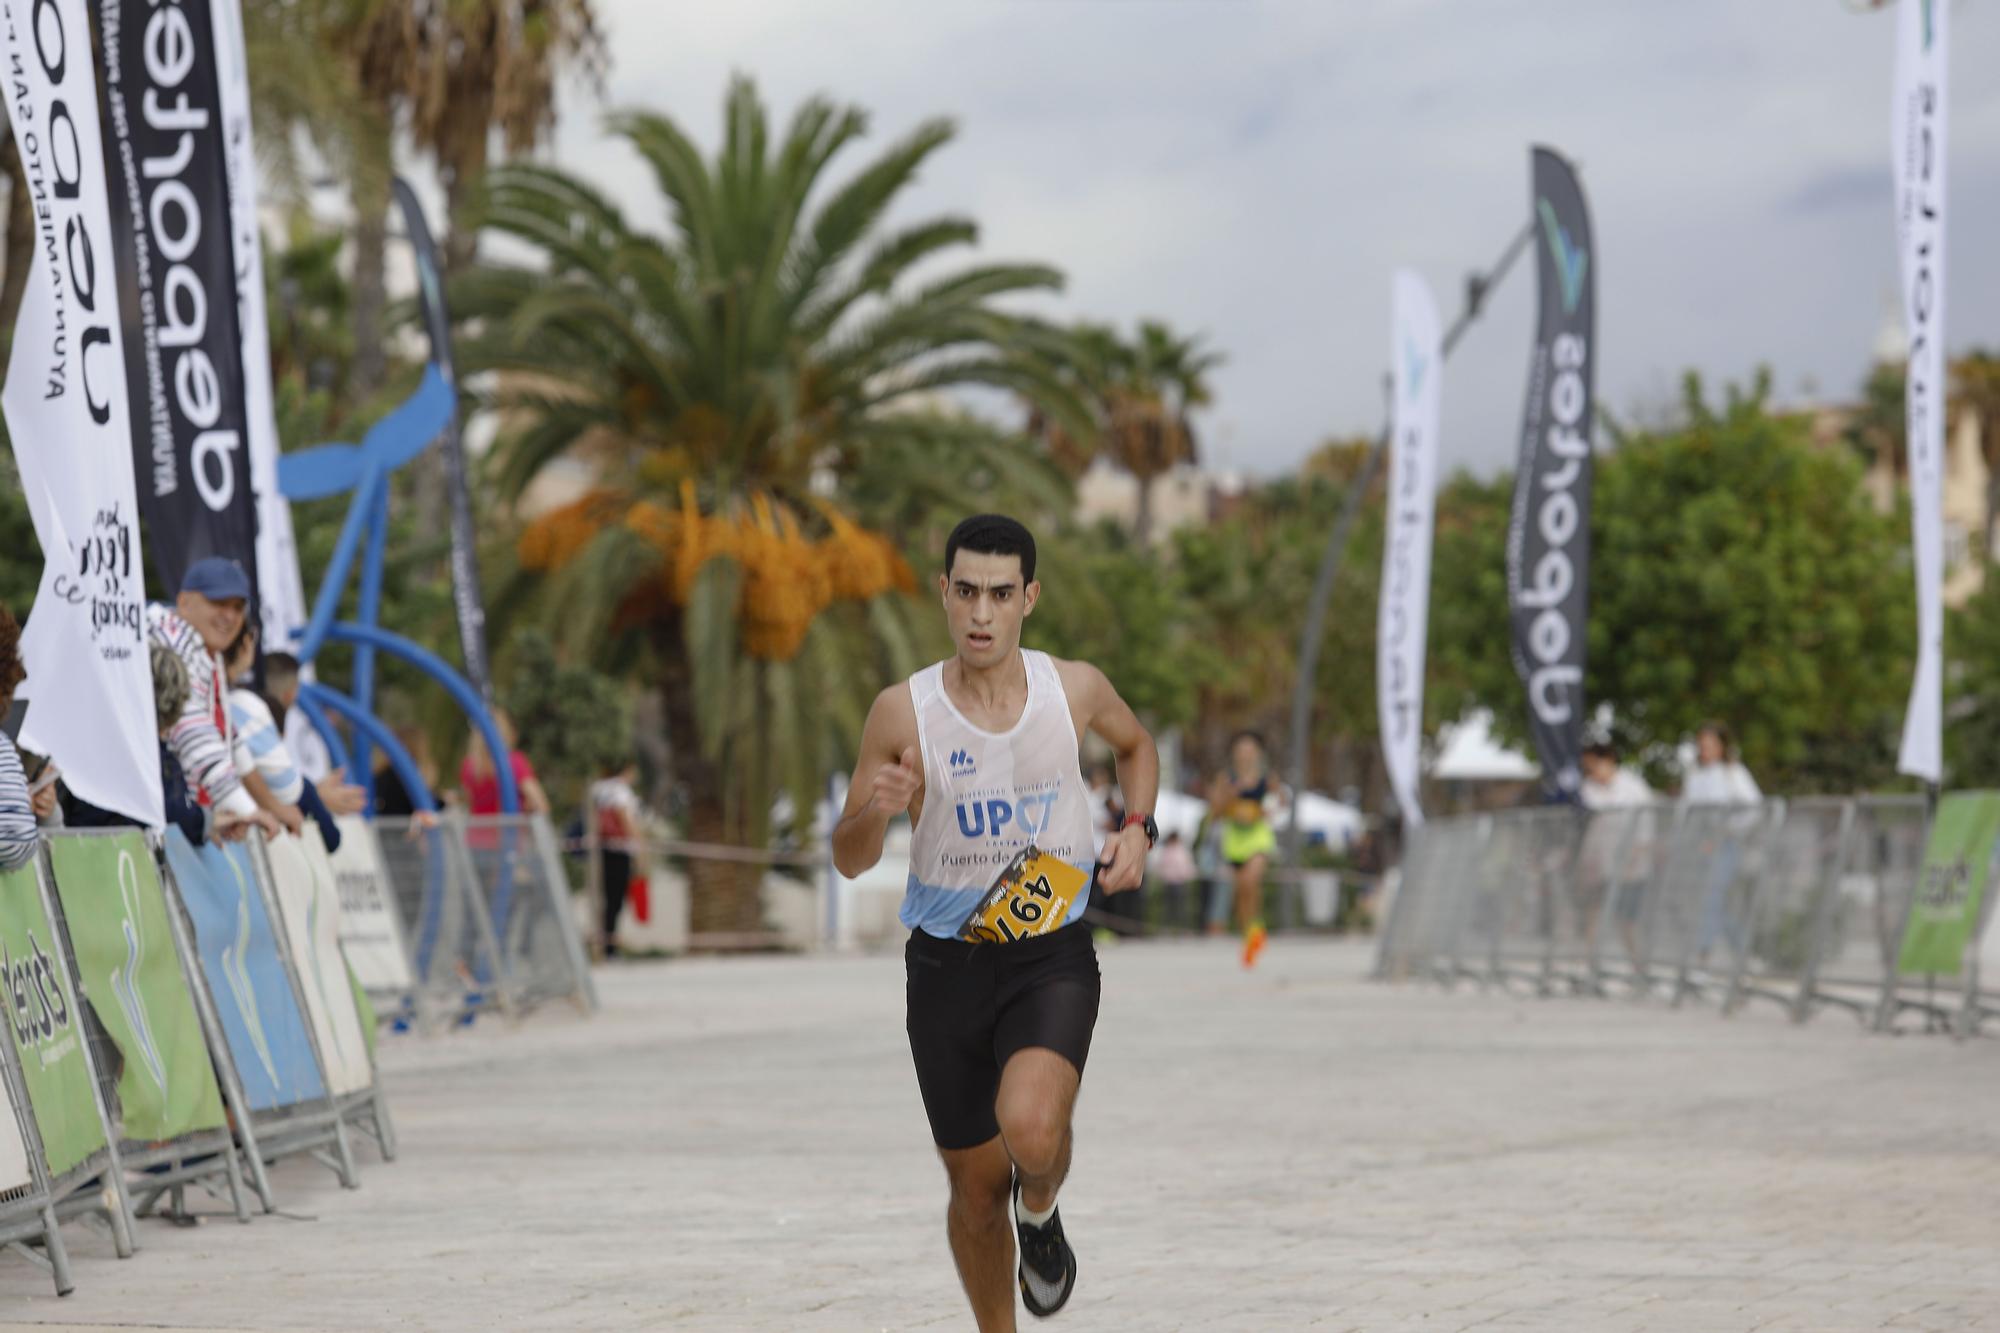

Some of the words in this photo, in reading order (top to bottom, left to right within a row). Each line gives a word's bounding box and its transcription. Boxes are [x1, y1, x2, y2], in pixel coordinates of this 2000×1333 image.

[954, 788, 1006, 800] UNIVERSIDAD
[956, 792, 1058, 838] UPCT
[941, 852, 987, 866] Puerto
[992, 850, 1010, 864] de
